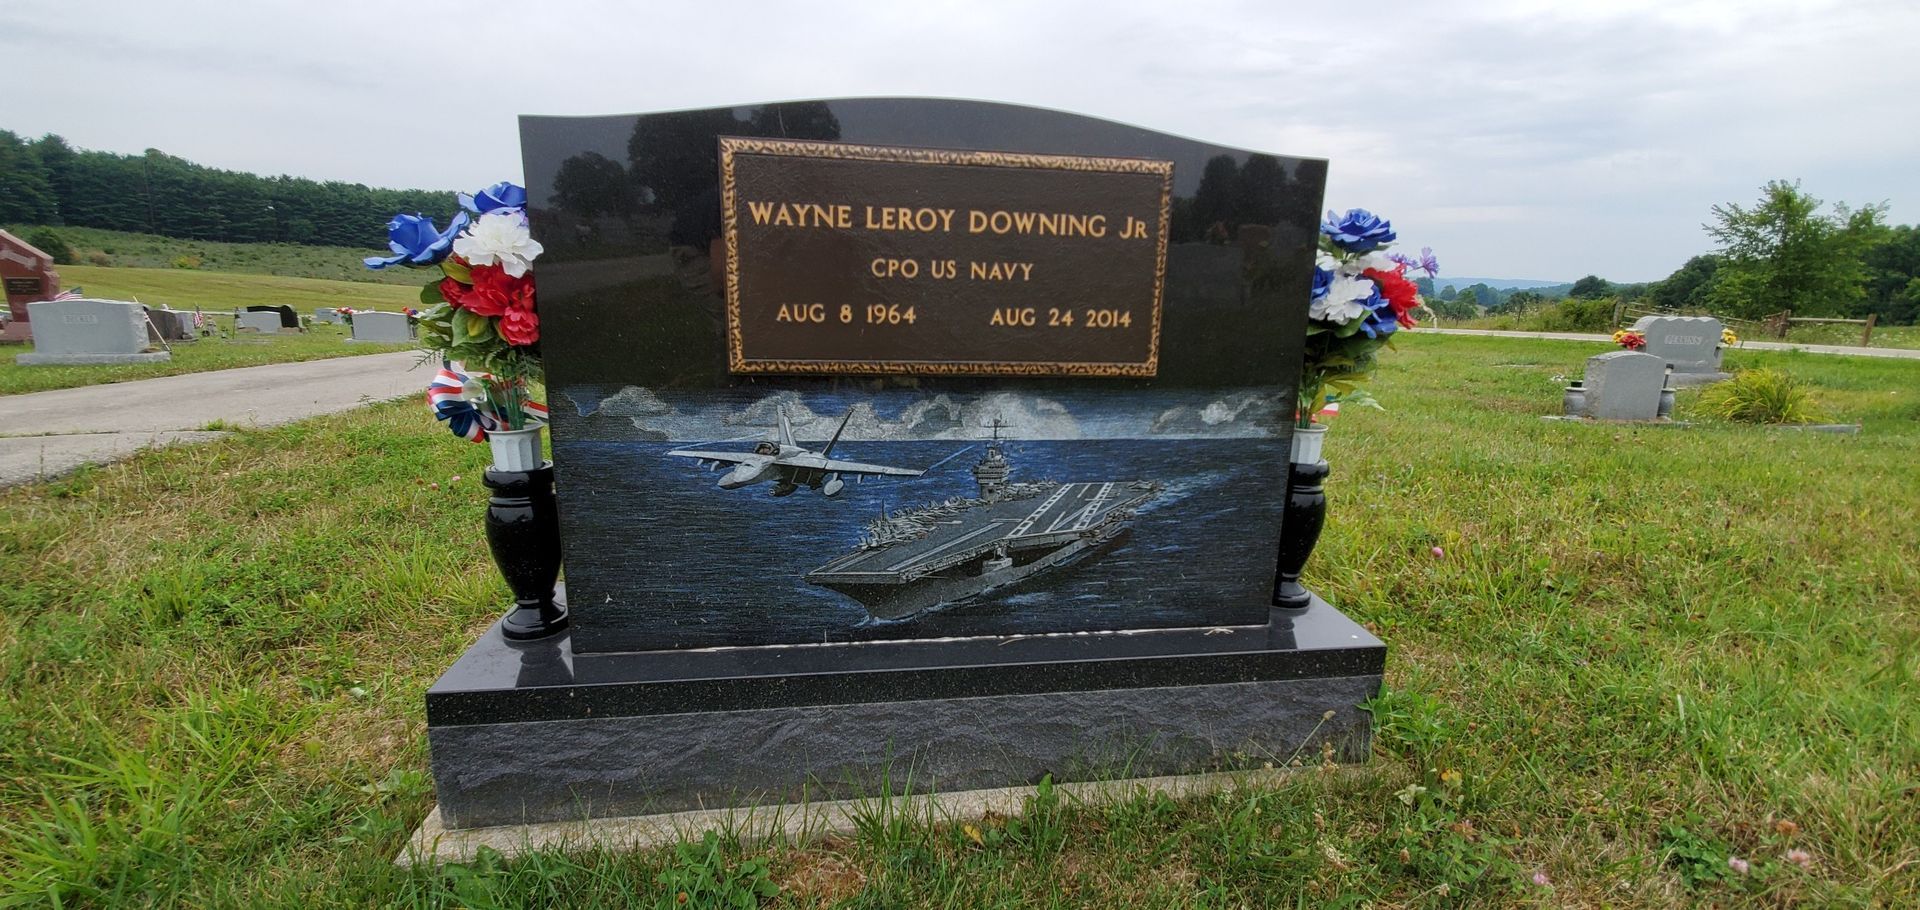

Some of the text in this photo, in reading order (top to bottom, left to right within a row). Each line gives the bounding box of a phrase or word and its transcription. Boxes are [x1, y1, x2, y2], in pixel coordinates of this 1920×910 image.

[747, 201, 853, 229] WAYNE
[865, 206, 956, 232] LEROY
[969, 210, 1107, 239] DOWNING
[871, 258, 1034, 281] CPO US NAVY
[776, 303, 918, 325] AUG 8 1964
[990, 307, 1133, 329] AUG 24 2014
